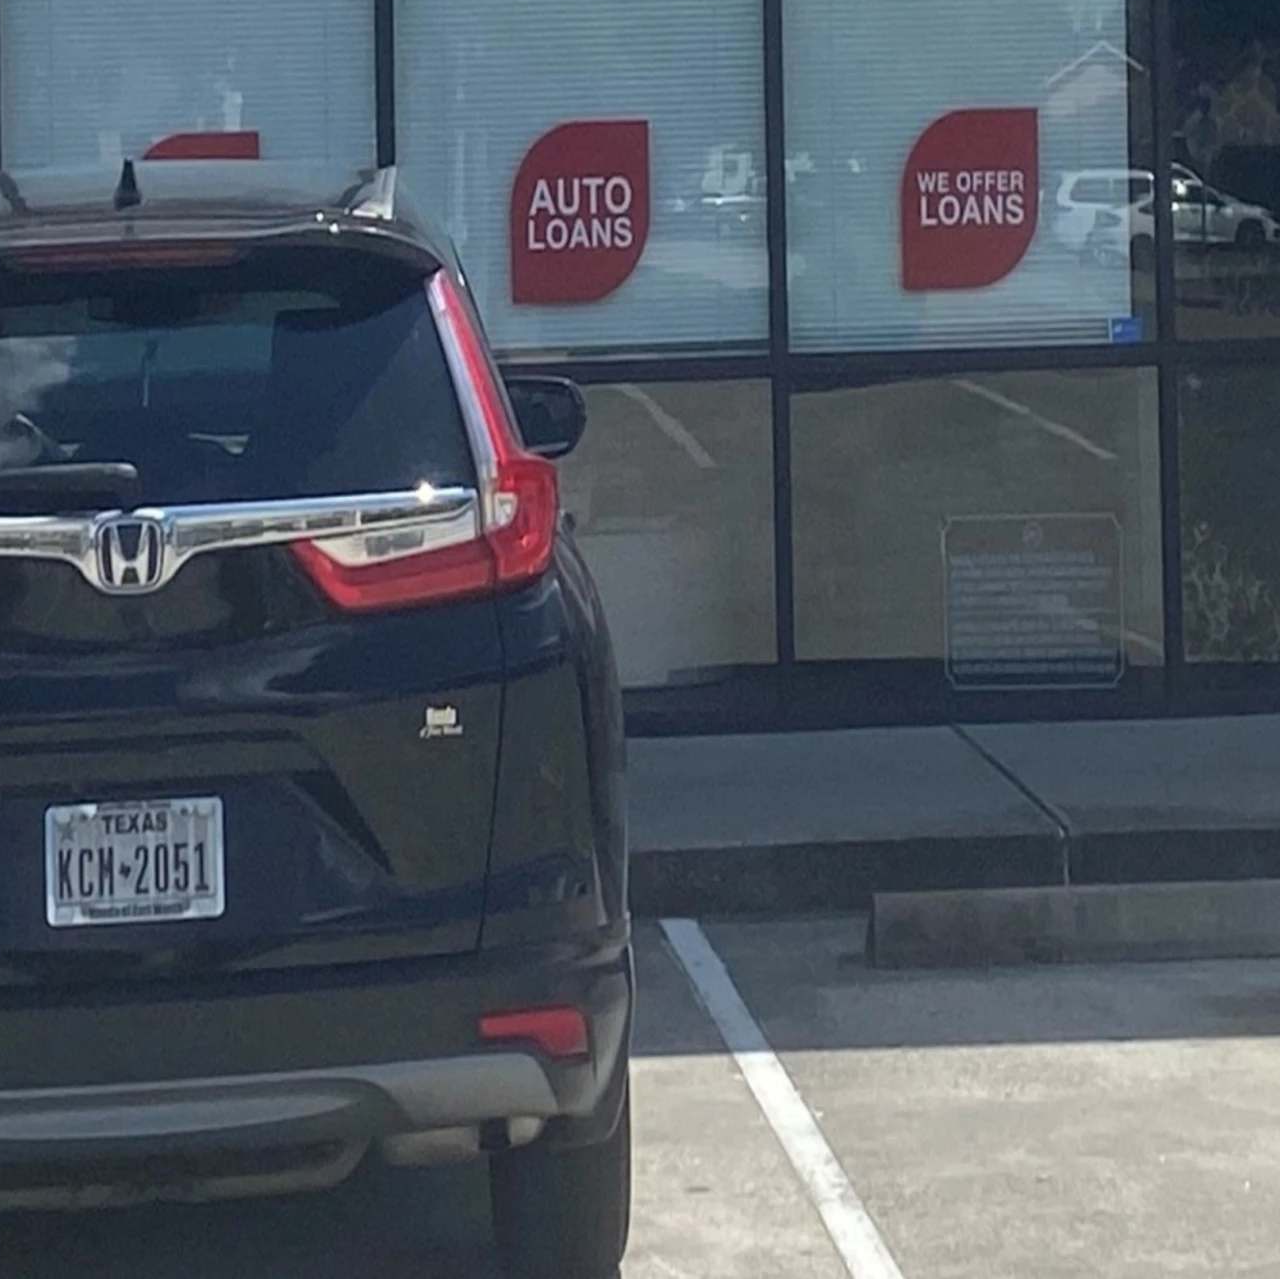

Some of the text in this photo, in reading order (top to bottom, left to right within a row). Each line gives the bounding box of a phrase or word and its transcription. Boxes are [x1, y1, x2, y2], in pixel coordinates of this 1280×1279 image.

[530, 177, 632, 216] AUTO
[917, 170, 1024, 193] WE OFFER
[921, 194, 1024, 226] LOANS
[528, 217, 633, 250] LOANS
[102, 810, 167, 835] TEXAS
